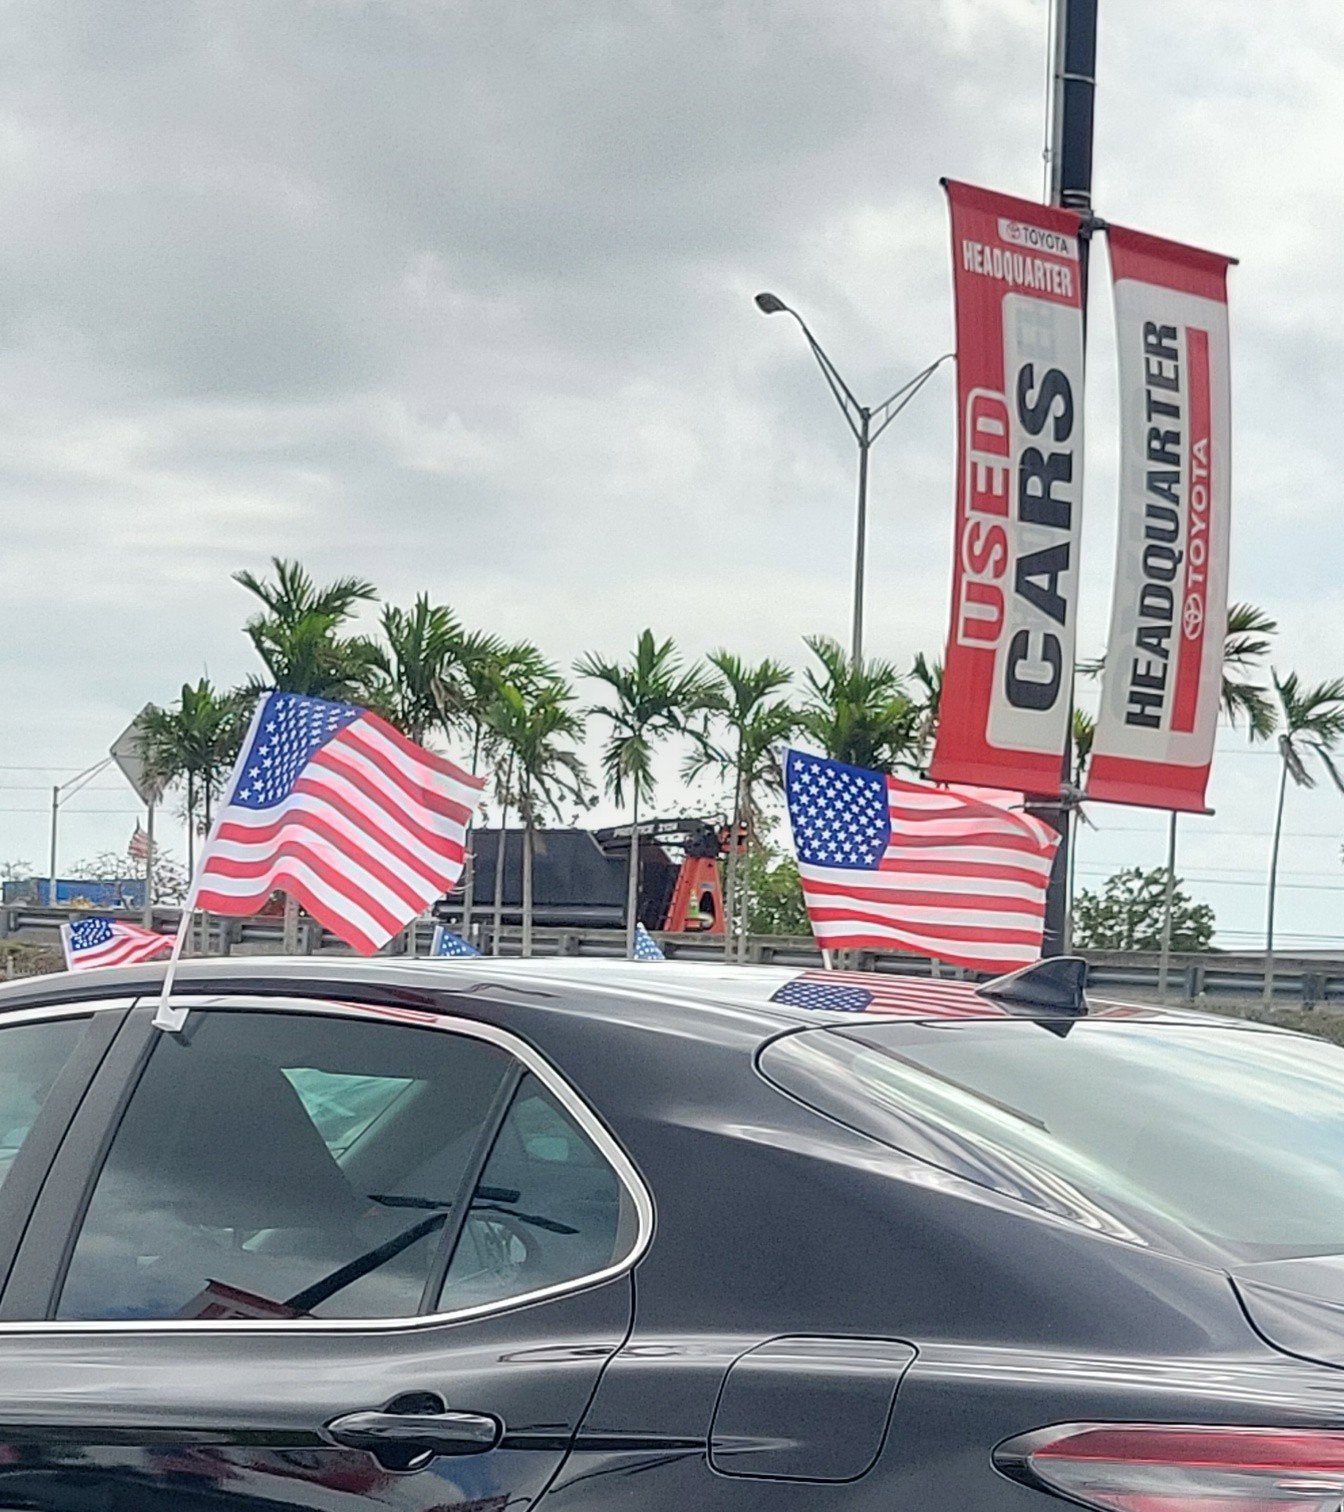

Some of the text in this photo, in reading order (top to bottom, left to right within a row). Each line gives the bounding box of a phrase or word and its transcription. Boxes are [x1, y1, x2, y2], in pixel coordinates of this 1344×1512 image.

[962, 239, 1073, 298] HEADQUARTER
[1022, 227, 1069, 255] TOYOTA
[956, 386, 1011, 650] USED
[1004, 362, 1074, 712] CARS
[1124, 320, 1183, 730] HEADQUARTER
[1186, 437, 1210, 588] TOYOTA
